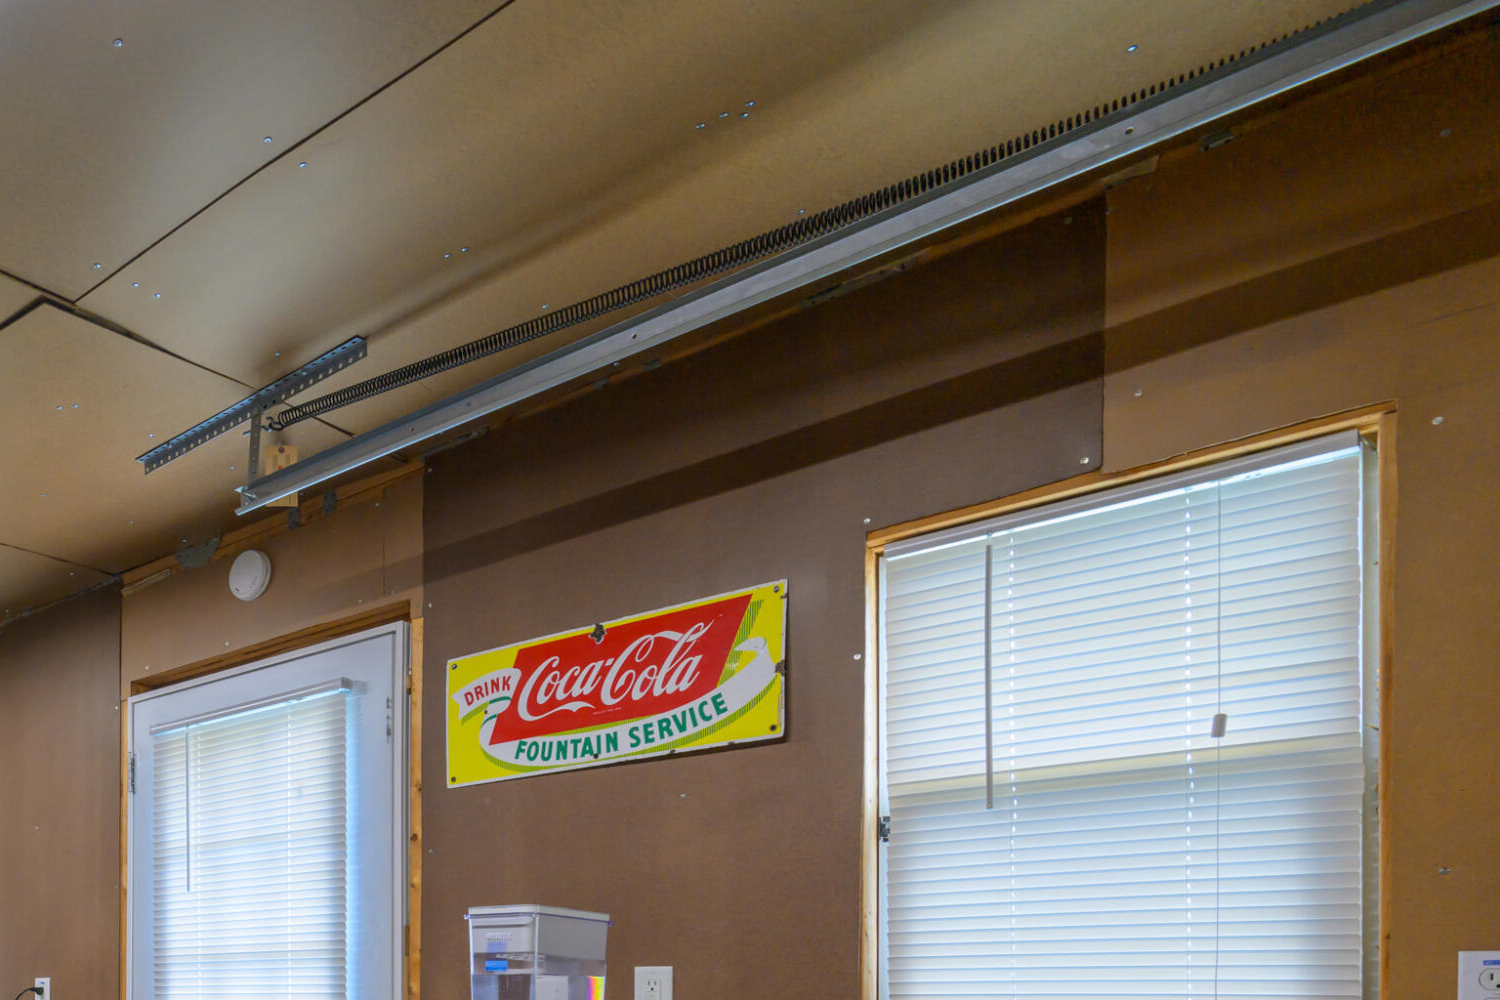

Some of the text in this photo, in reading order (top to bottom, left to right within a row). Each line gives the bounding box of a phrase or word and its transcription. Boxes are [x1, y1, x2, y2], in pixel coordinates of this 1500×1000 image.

[463, 674, 511, 707] DRINK
[517, 617, 715, 722] Coca-Cola
[514, 692, 729, 763] FOUNTAIN SERVICE
